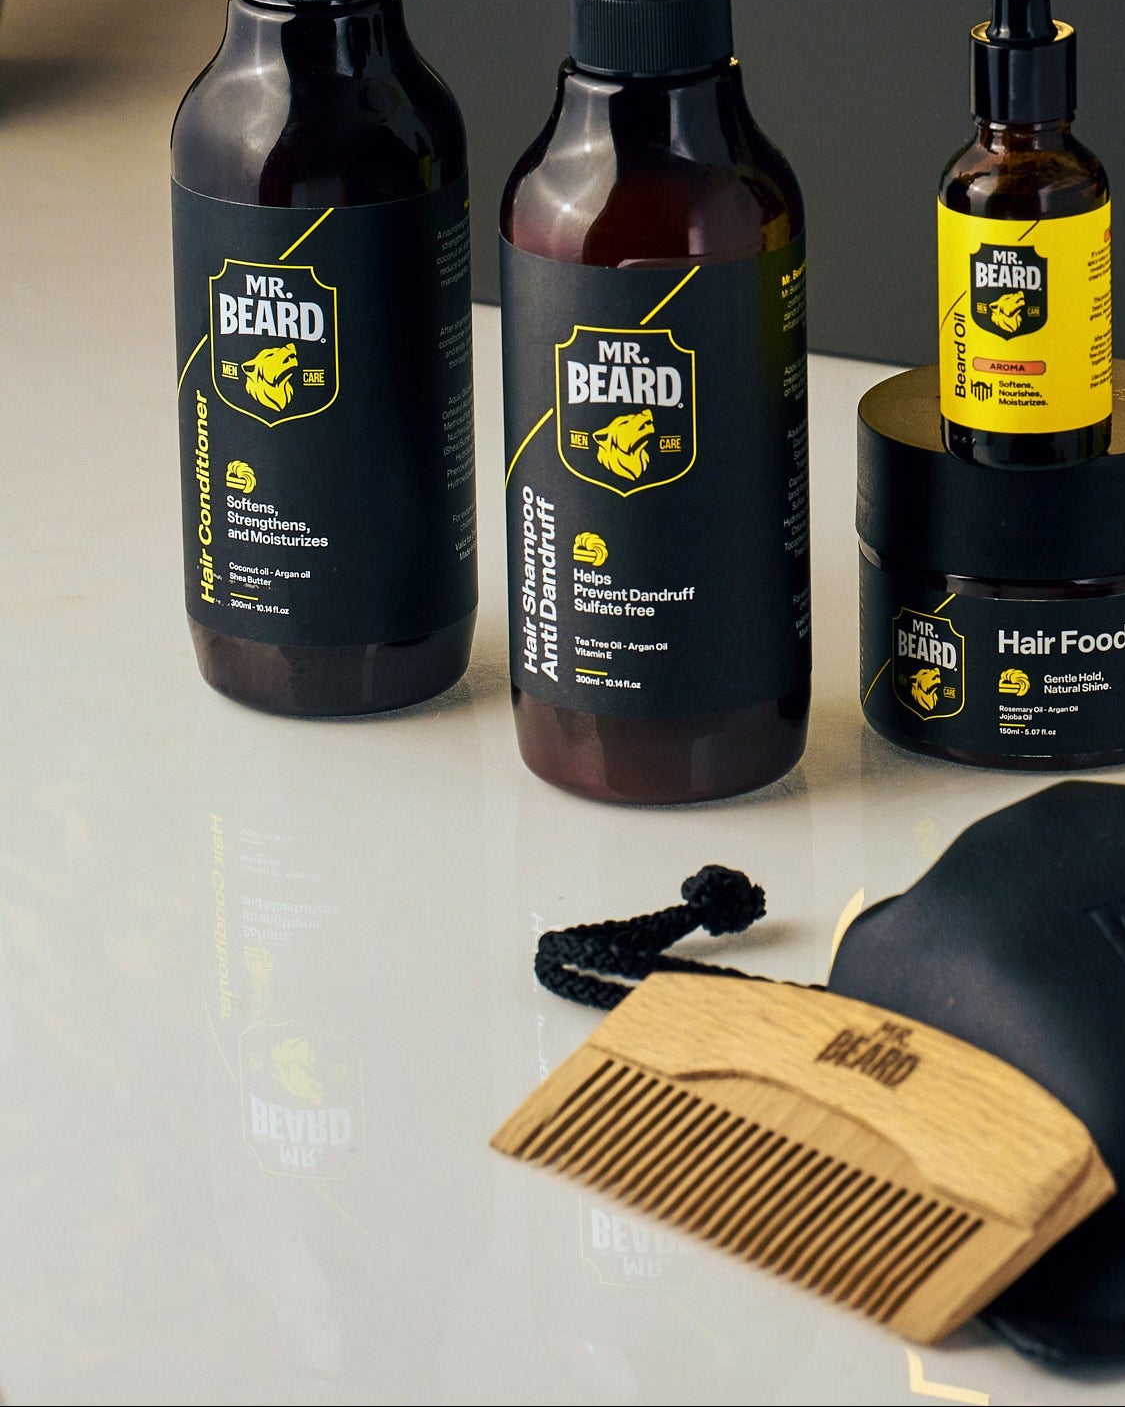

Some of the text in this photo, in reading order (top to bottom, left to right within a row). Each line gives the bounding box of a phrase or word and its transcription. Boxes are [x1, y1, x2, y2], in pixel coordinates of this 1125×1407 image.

[992, 250, 1023, 265] MR.
[975, 261, 1042, 291] BEARD
[245, 274, 294, 300] MR.
[598, 340, 650, 365] MR.
[954, 312, 966, 398] Beard Oil
[222, 364, 238, 377] MEN
[990, 363, 1026, 372] AROMA
[303, 372, 325, 383] CARE
[998, 380, 1034, 389] Softens,
[998, 389, 1043, 398] Nourishes,
[998, 398, 1049, 406] Moisturizes.
[570, 433, 588, 446] MEN
[660, 438, 681, 450] CARE
[195, 390, 215, 604] Hair Conditioner
[226, 495, 279, 517] Softens,
[227, 510, 311, 534] Strengthens,
[227, 529, 329, 547] and Moisturizes
[228, 562, 259, 575] Coconut
[259, 567, 269, 576] oil
[274, 569, 300, 579] Argan
[300, 571, 311, 579] oil
[573, 568, 612, 586] Helps
[229, 572, 272, 586] Shea Butter
[522, 485, 538, 675] Hair Shampoo
[536, 495, 559, 683] Anti Dandruff
[573, 583, 695, 602] Prevent Dandruff
[230, 599, 252, 610] 300ml
[256, 604, 272, 613] 10.14
[574, 598, 655, 616] Sulfate free
[912, 618, 939, 639] MR.
[574, 636, 590, 647] Tea
[590, 639, 609, 649] Tree
[610, 641, 622, 650] Oil
[628, 643, 655, 652] Argan
[655, 642, 668, 651] Oil
[898, 629, 957, 670] BEARD
[998, 629, 1056, 655] Hair
[575, 647, 613, 660] Vitamin E
[575, 675, 600, 686] 300ml
[605, 679, 623, 688] 10.14
[624, 680, 641, 689] fl.oz
[1044, 671, 1104, 684] Gentle Hold,
[1044, 682, 1112, 694] Natural Shine.
[999, 705, 1033, 714] Rosemary
[1048, 706, 1069, 714] Argan
[999, 713, 1022, 721] Jojoba
[816, 1028, 921, 1089] BEARD
